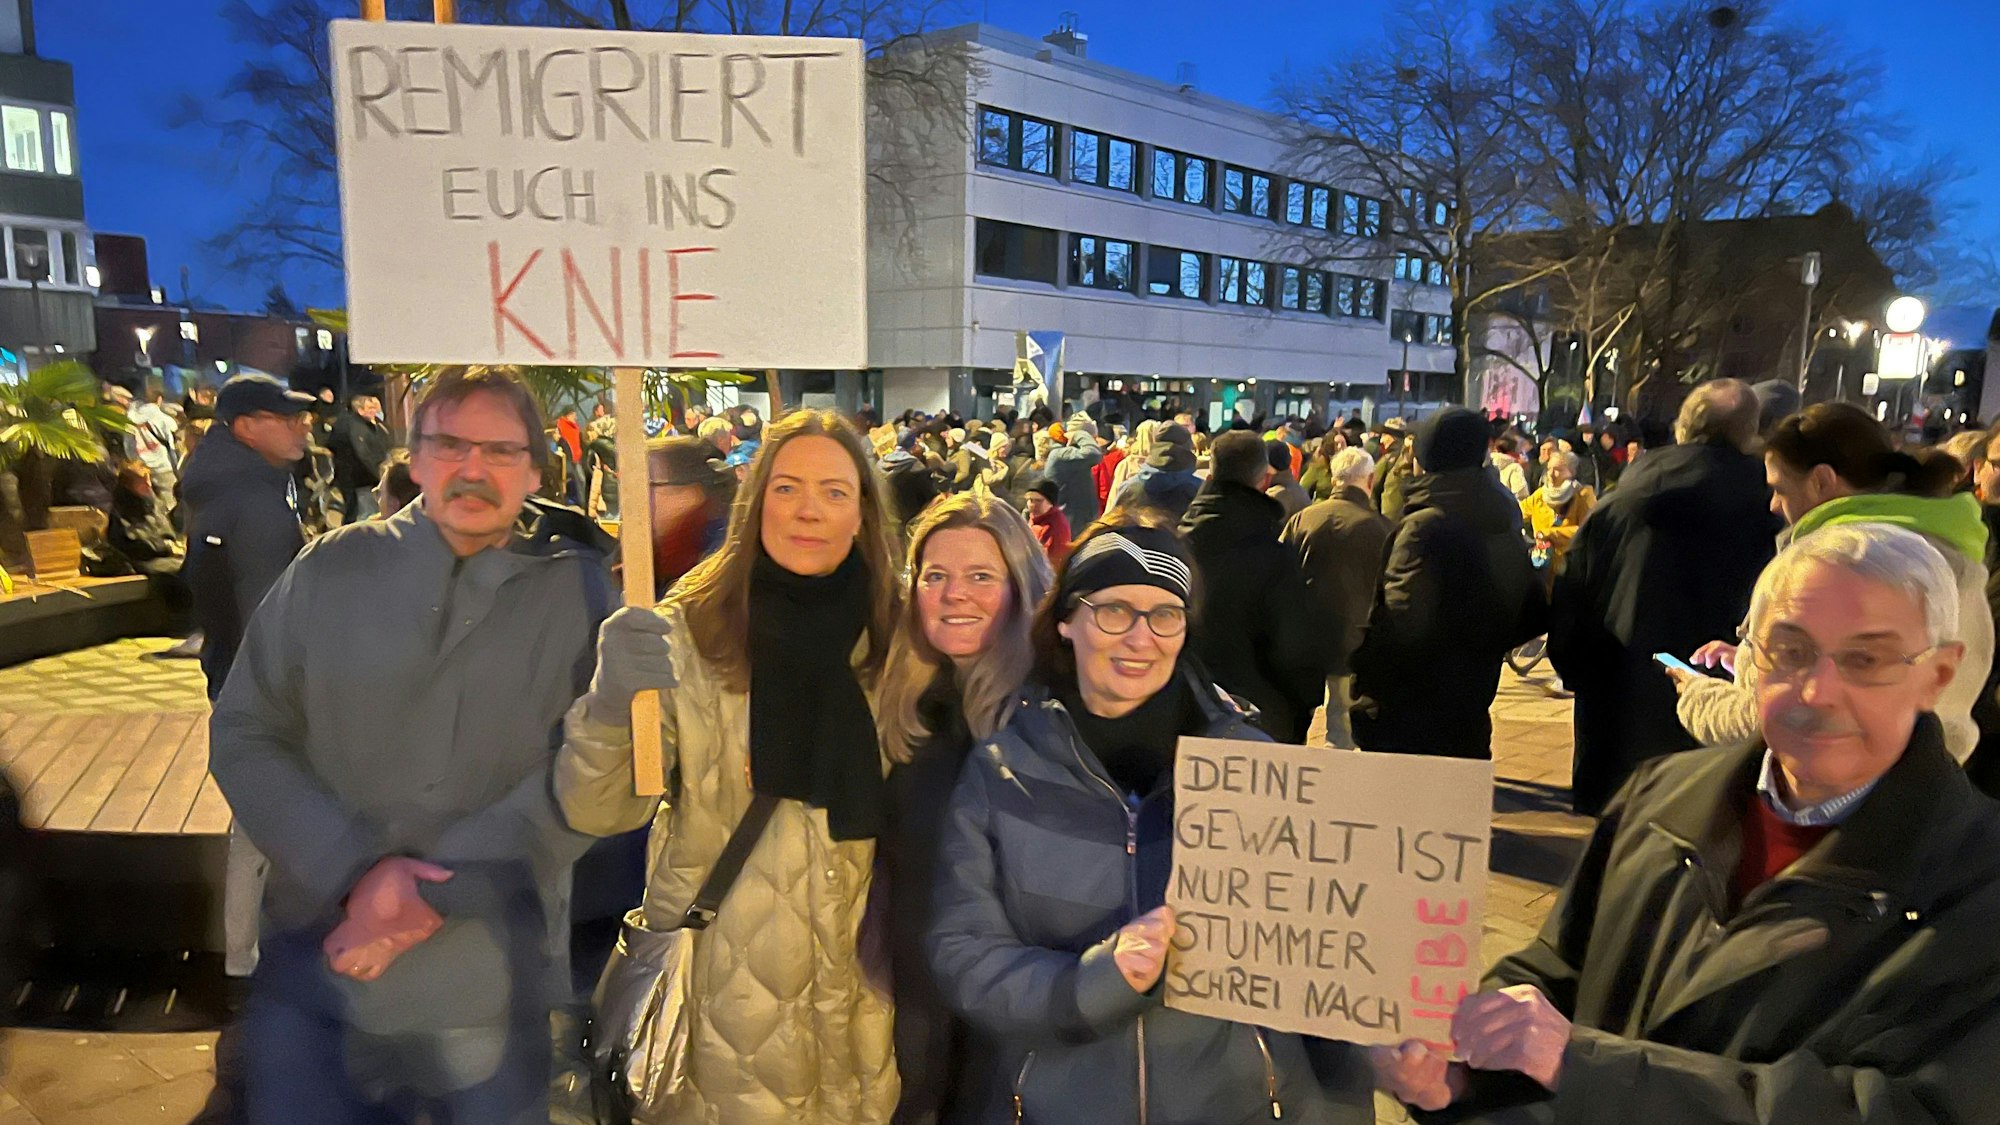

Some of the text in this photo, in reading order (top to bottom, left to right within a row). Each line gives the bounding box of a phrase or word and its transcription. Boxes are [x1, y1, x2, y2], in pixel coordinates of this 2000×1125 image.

[348, 45, 842, 156] REMIGRIERT
[442, 166, 736, 230] EUCH INS
[487, 241, 724, 360] KNIE
[1182, 755, 1321, 804] DEINE
[1176, 803, 1481, 883] GEWALT IST
[1177, 864, 1368, 919] NUR EIN
[1169, 911, 1376, 975] STUMMER
[1167, 962, 1400, 1033] SCHREI NACH
